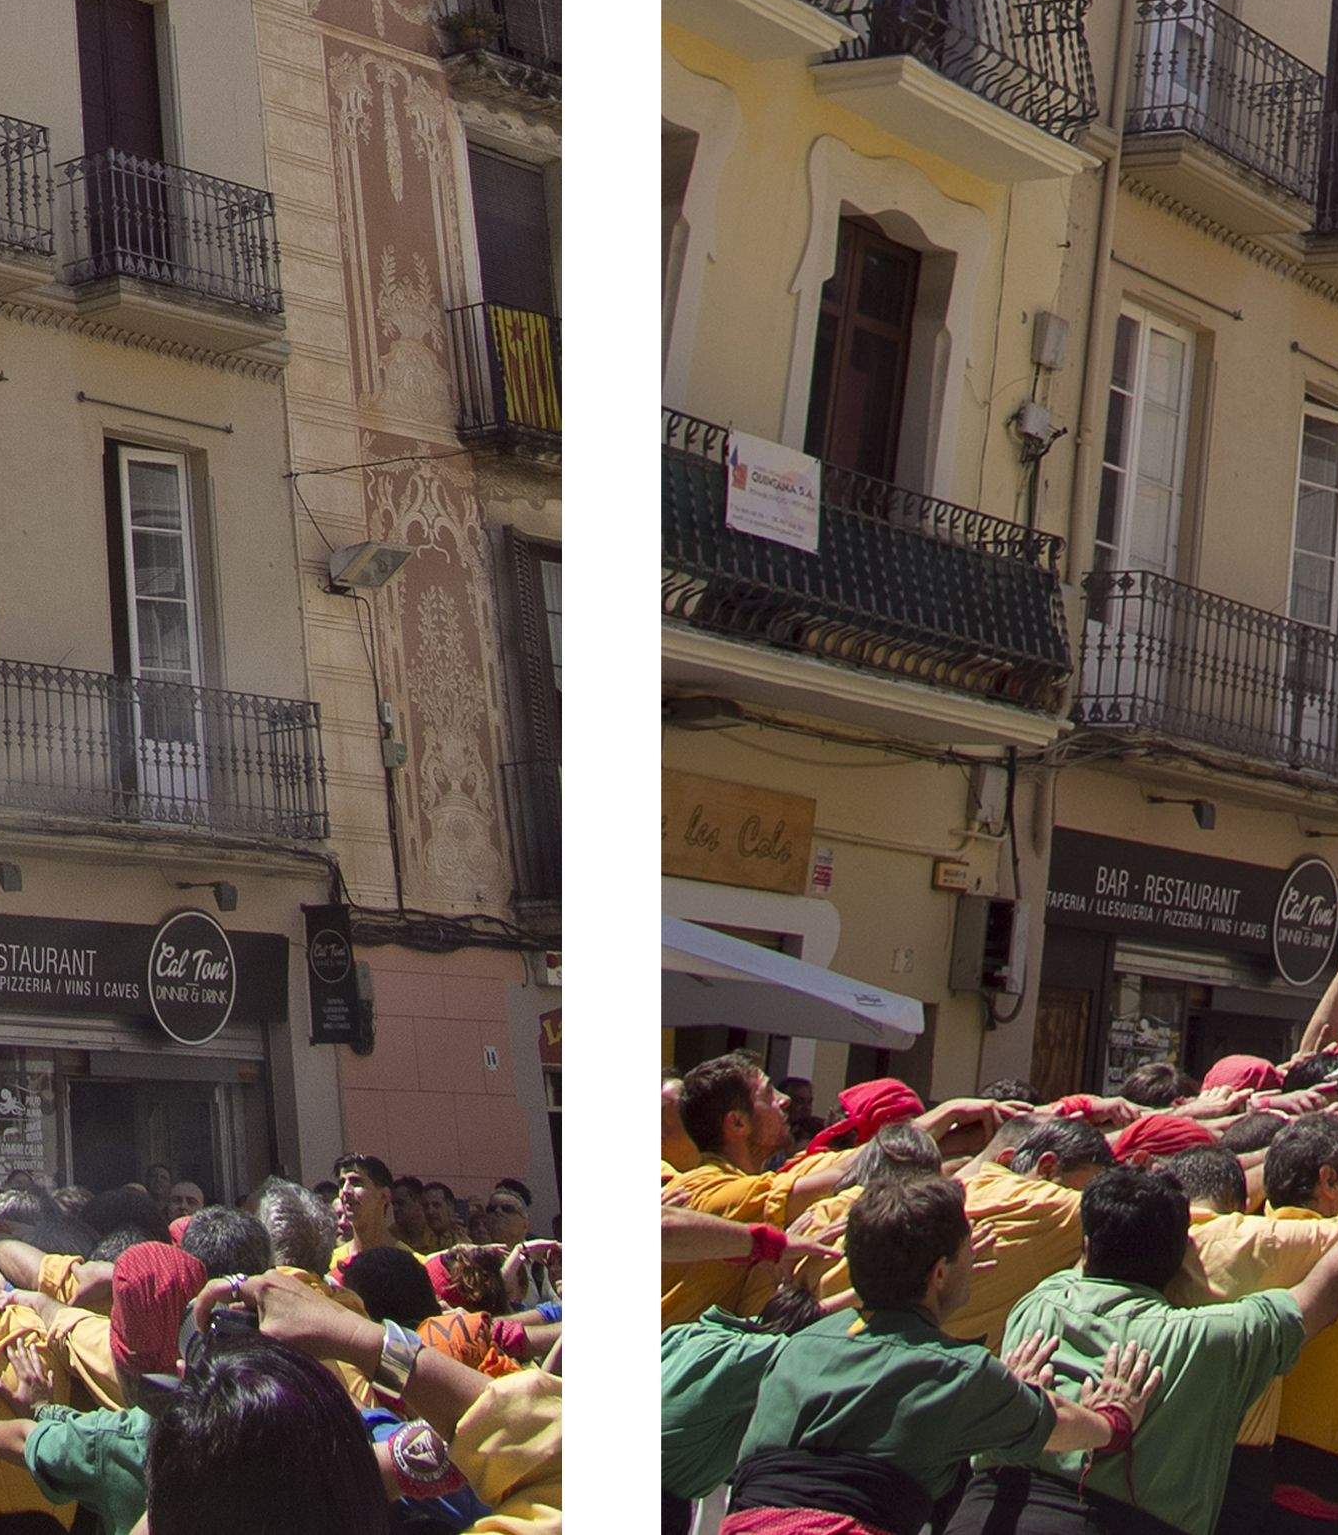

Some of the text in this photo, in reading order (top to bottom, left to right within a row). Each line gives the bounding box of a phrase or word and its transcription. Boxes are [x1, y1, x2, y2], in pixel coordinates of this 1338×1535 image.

[738, 815, 792, 863] Cols
[1095, 866, 1241, 915] BAR RESTAURANT
[1281, 886, 1336, 926] Cal Toni
[1046, 890, 1085, 912] TAPERIA
[1096, 900, 1153, 921] LLESQUERIA
[1163, 909, 1203, 929] PIZZERIA
[1212, 917, 1232, 934] VINS
[1240, 922, 1268, 939] CAVES
[156, 942, 229, 981] Cal Toni
[0, 977, 52, 994] PIZZERIA
[64, 980, 91, 996] VINS
[103, 982, 139, 999] CAVES
[156, 984, 188, 1002] DINNER
[201, 989, 228, 1004] DRINK
